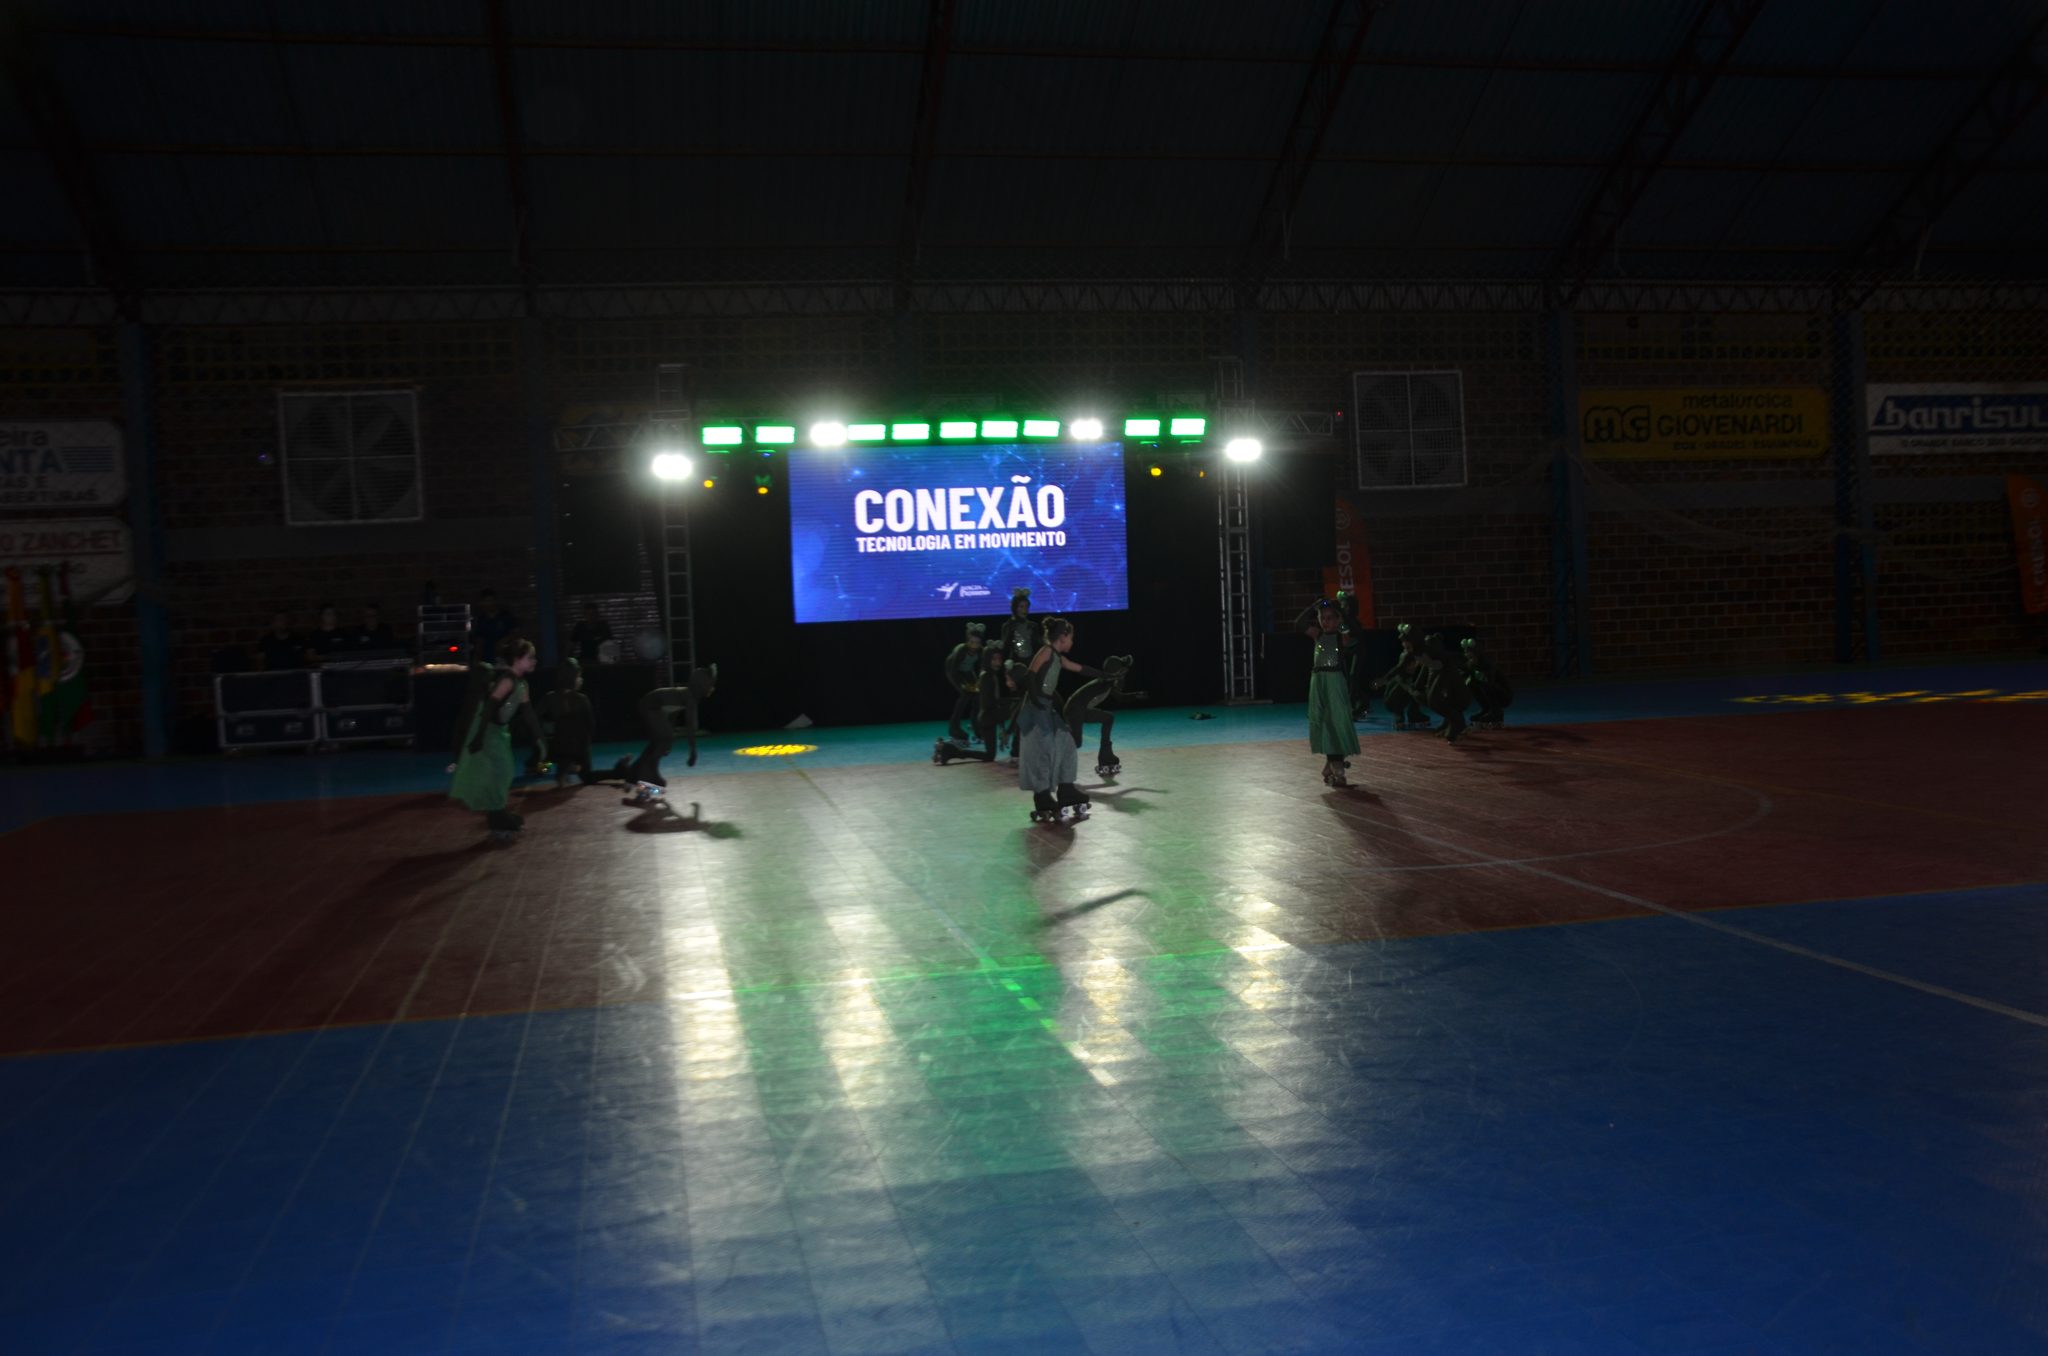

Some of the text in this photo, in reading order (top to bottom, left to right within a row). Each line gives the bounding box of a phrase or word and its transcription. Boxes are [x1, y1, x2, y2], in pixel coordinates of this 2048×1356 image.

[1656, 412, 1804, 437] GIOVENARDI
[1868, 394, 2048, 431] banrisul
[854, 474, 1065, 534] CONEXÃO
[855, 530, 1067, 553] TECNOLOGIA EM MOVIMENTO
